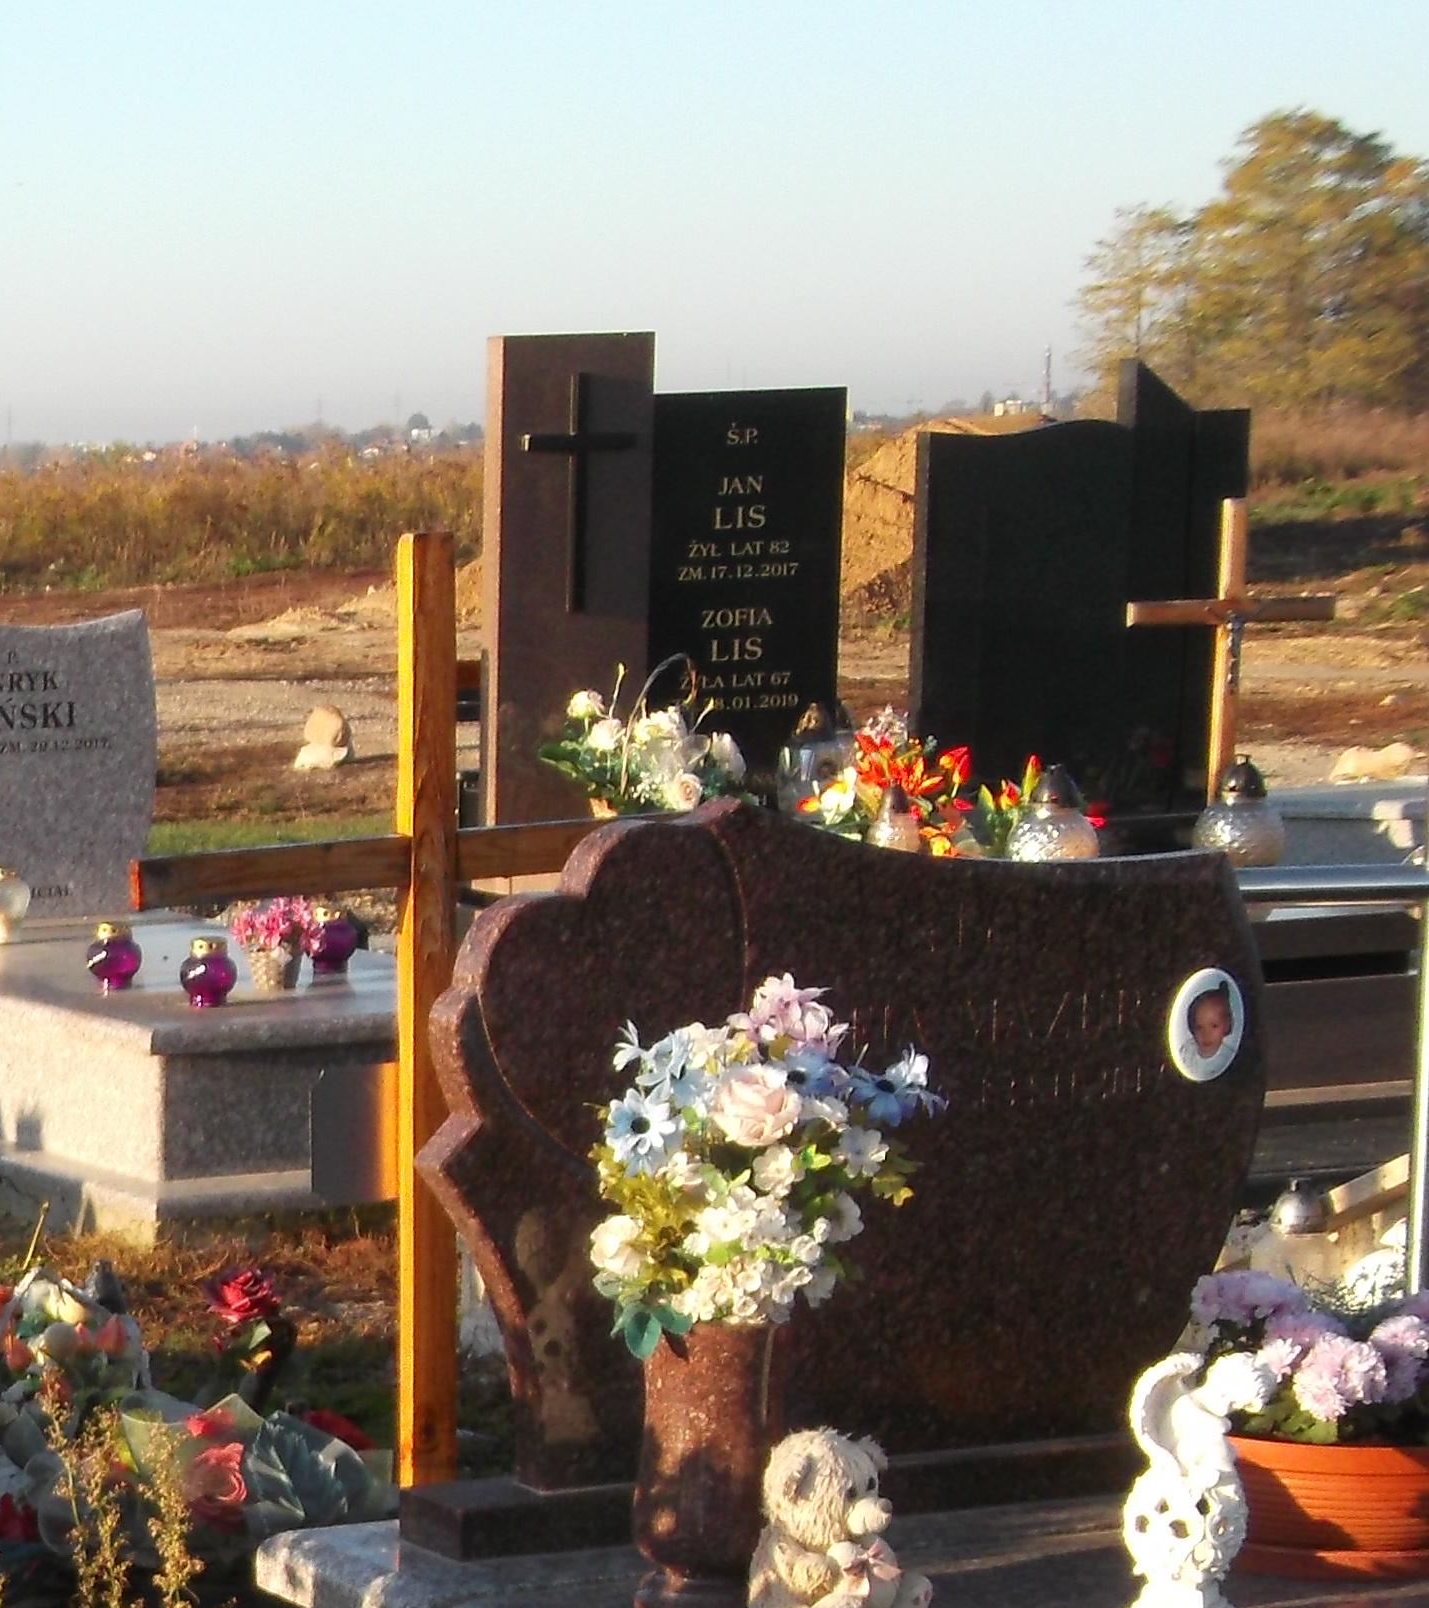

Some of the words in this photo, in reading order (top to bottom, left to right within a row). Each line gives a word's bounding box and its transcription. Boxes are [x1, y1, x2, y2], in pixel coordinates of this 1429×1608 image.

[717, 475, 764, 496] JAN
[714, 504, 767, 530] LIS
[730, 541, 765, 557] LAT
[769, 539, 791, 555] 82
[701, 606, 774, 629] ZOFIA
[710, 636, 764, 662] LIS
[731, 672, 765, 688] LAT
[769, 670, 793, 686] 67
